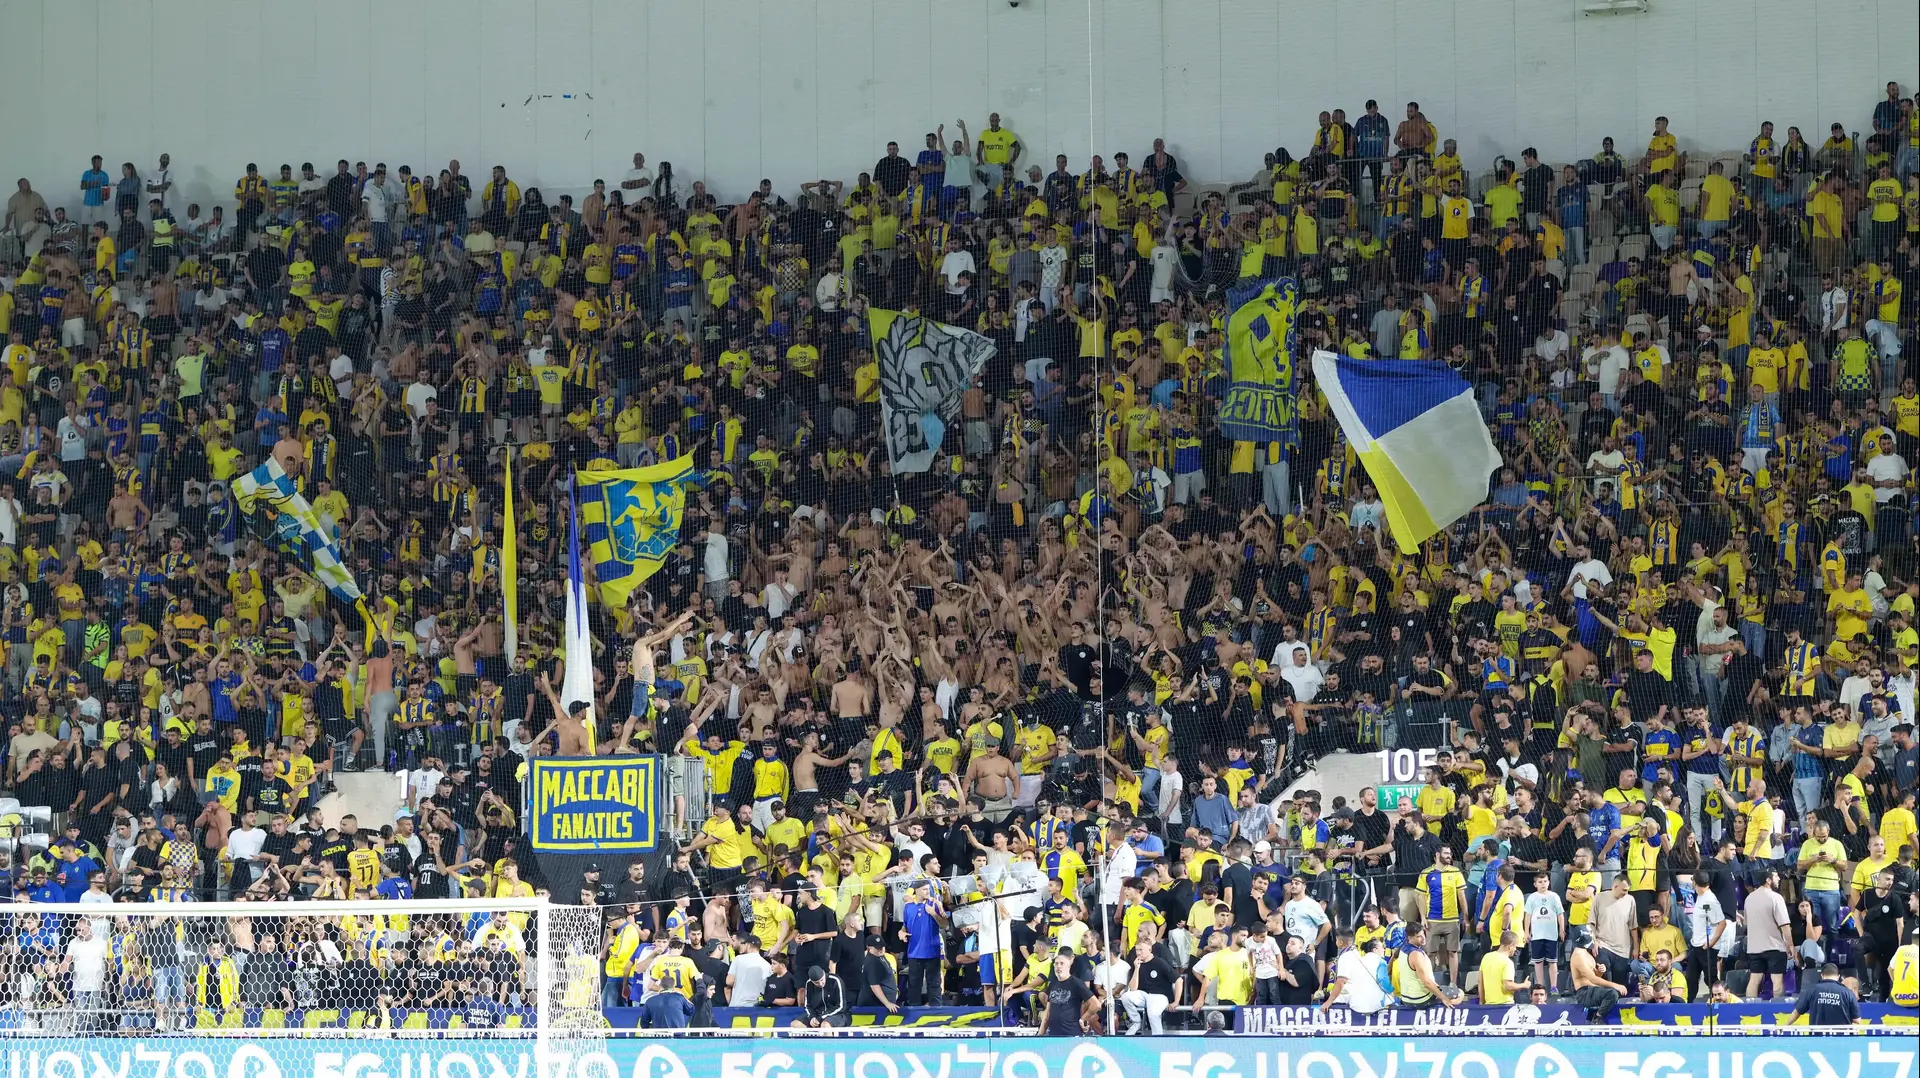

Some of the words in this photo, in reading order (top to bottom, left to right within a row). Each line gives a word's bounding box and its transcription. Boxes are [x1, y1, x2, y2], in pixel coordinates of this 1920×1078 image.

[1376, 748, 1437, 782] 105
[542, 768, 646, 816] MACCABI
[552, 811, 632, 839] FANATICS
[357, 865, 374, 882] 77
[421, 871, 431, 884] 01
[1902, 961, 1911, 982] 7
[1894, 993, 1918, 1001] CARGO
[1243, 1006, 1351, 1036] MACCABI
[721, 1052, 801, 1078] 5G
[1159, 1052, 1242, 1078] 5G
[1604, 1052, 1689, 1078] 5G
